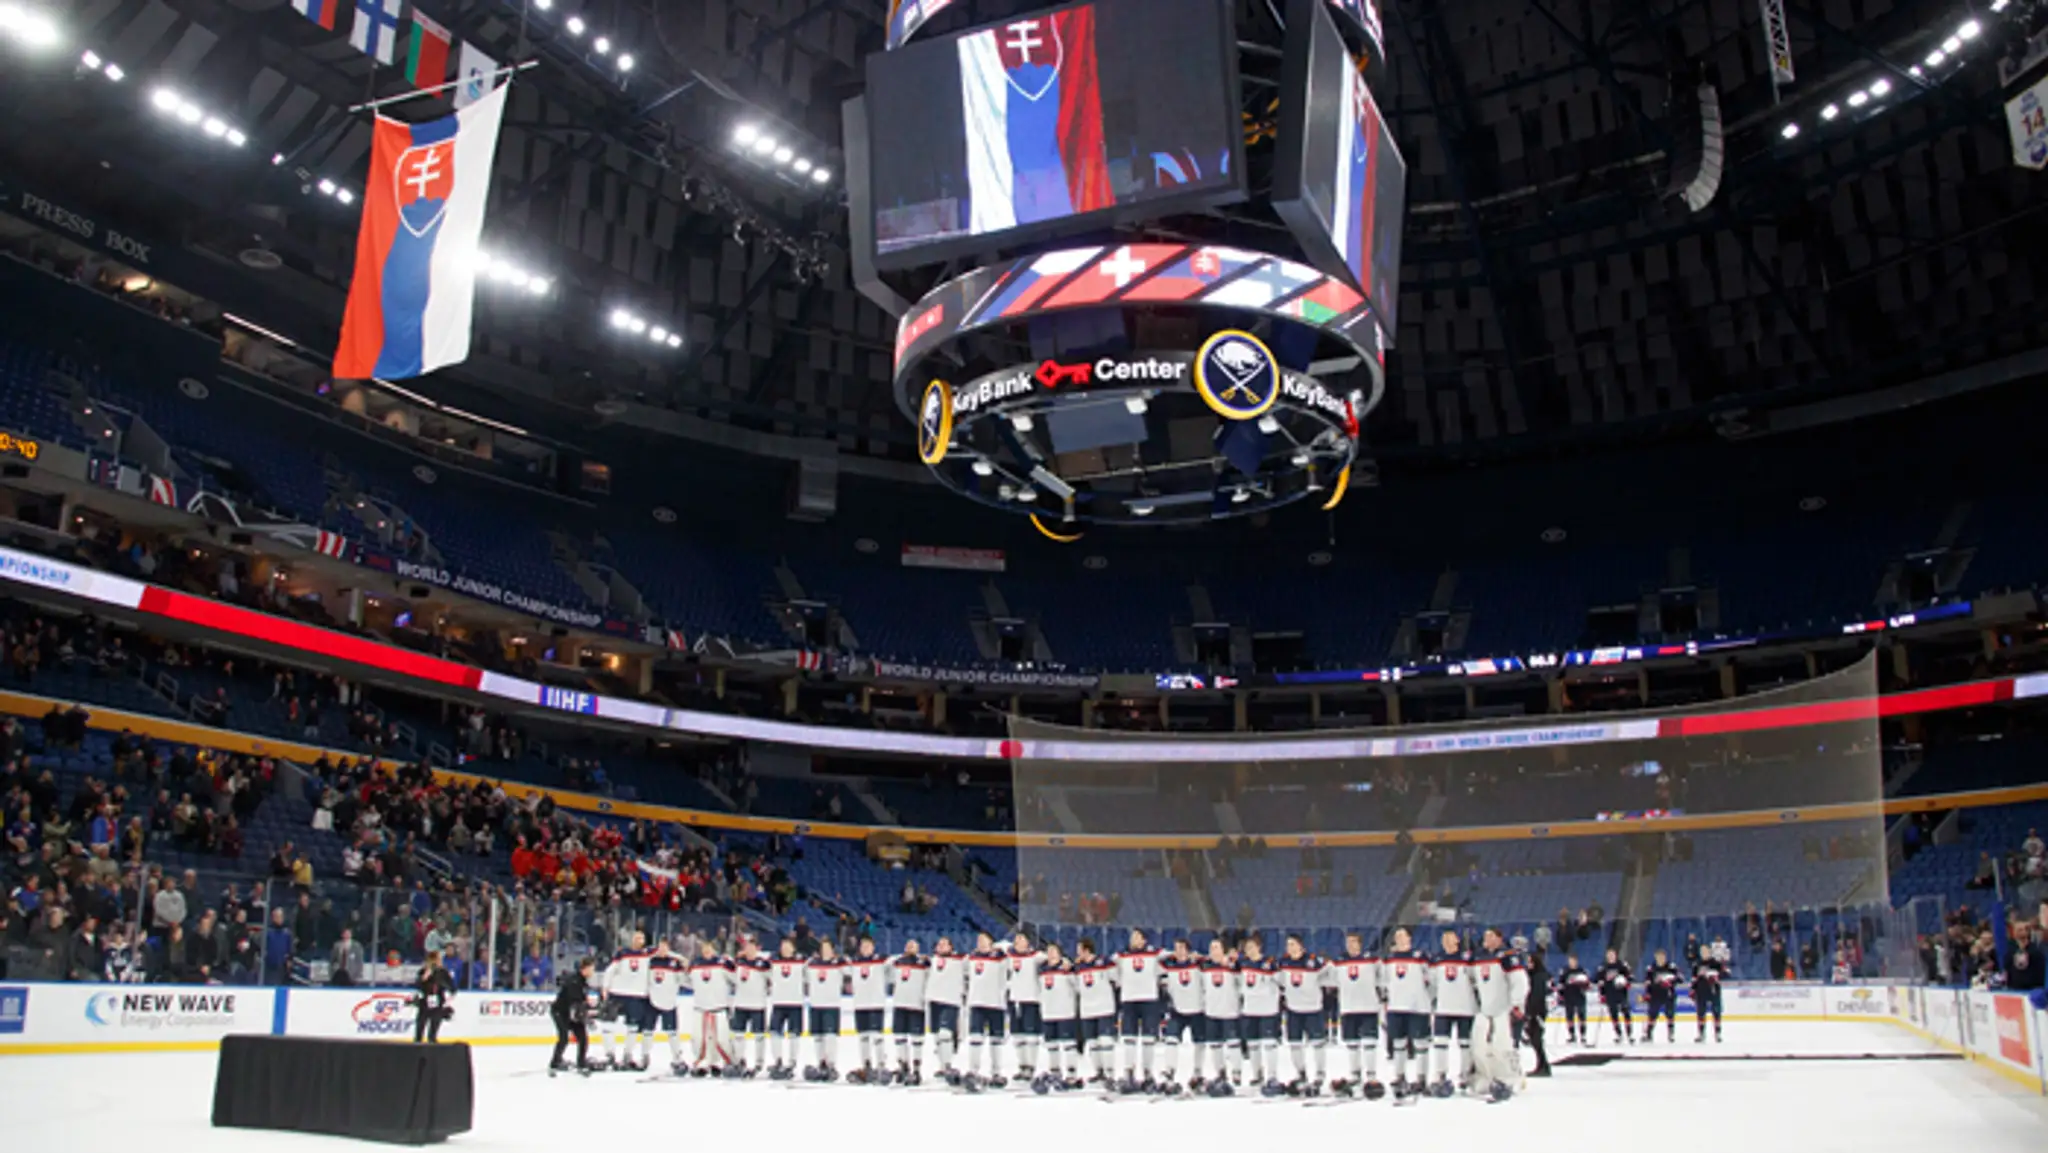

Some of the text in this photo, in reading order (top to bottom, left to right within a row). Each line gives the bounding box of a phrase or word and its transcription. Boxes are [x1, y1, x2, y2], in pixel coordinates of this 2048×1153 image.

[2022, 106, 2046, 136] 14
[21, 192, 151, 263] PRESS BOX
[1095, 358, 1187, 380] Center
[397, 559, 450, 585] WORLD
[453, 575, 501, 602] JUNIOR
[503, 590, 601, 628] CHAMPIONSHIP
[881, 664, 1099, 687] WORLD JUNIOR CHAMPIONSHIP
[546, 686, 590, 712] IIHF
[123, 994, 235, 1013] NEW WAVE
[357, 1019, 415, 1033] HOCKEY
